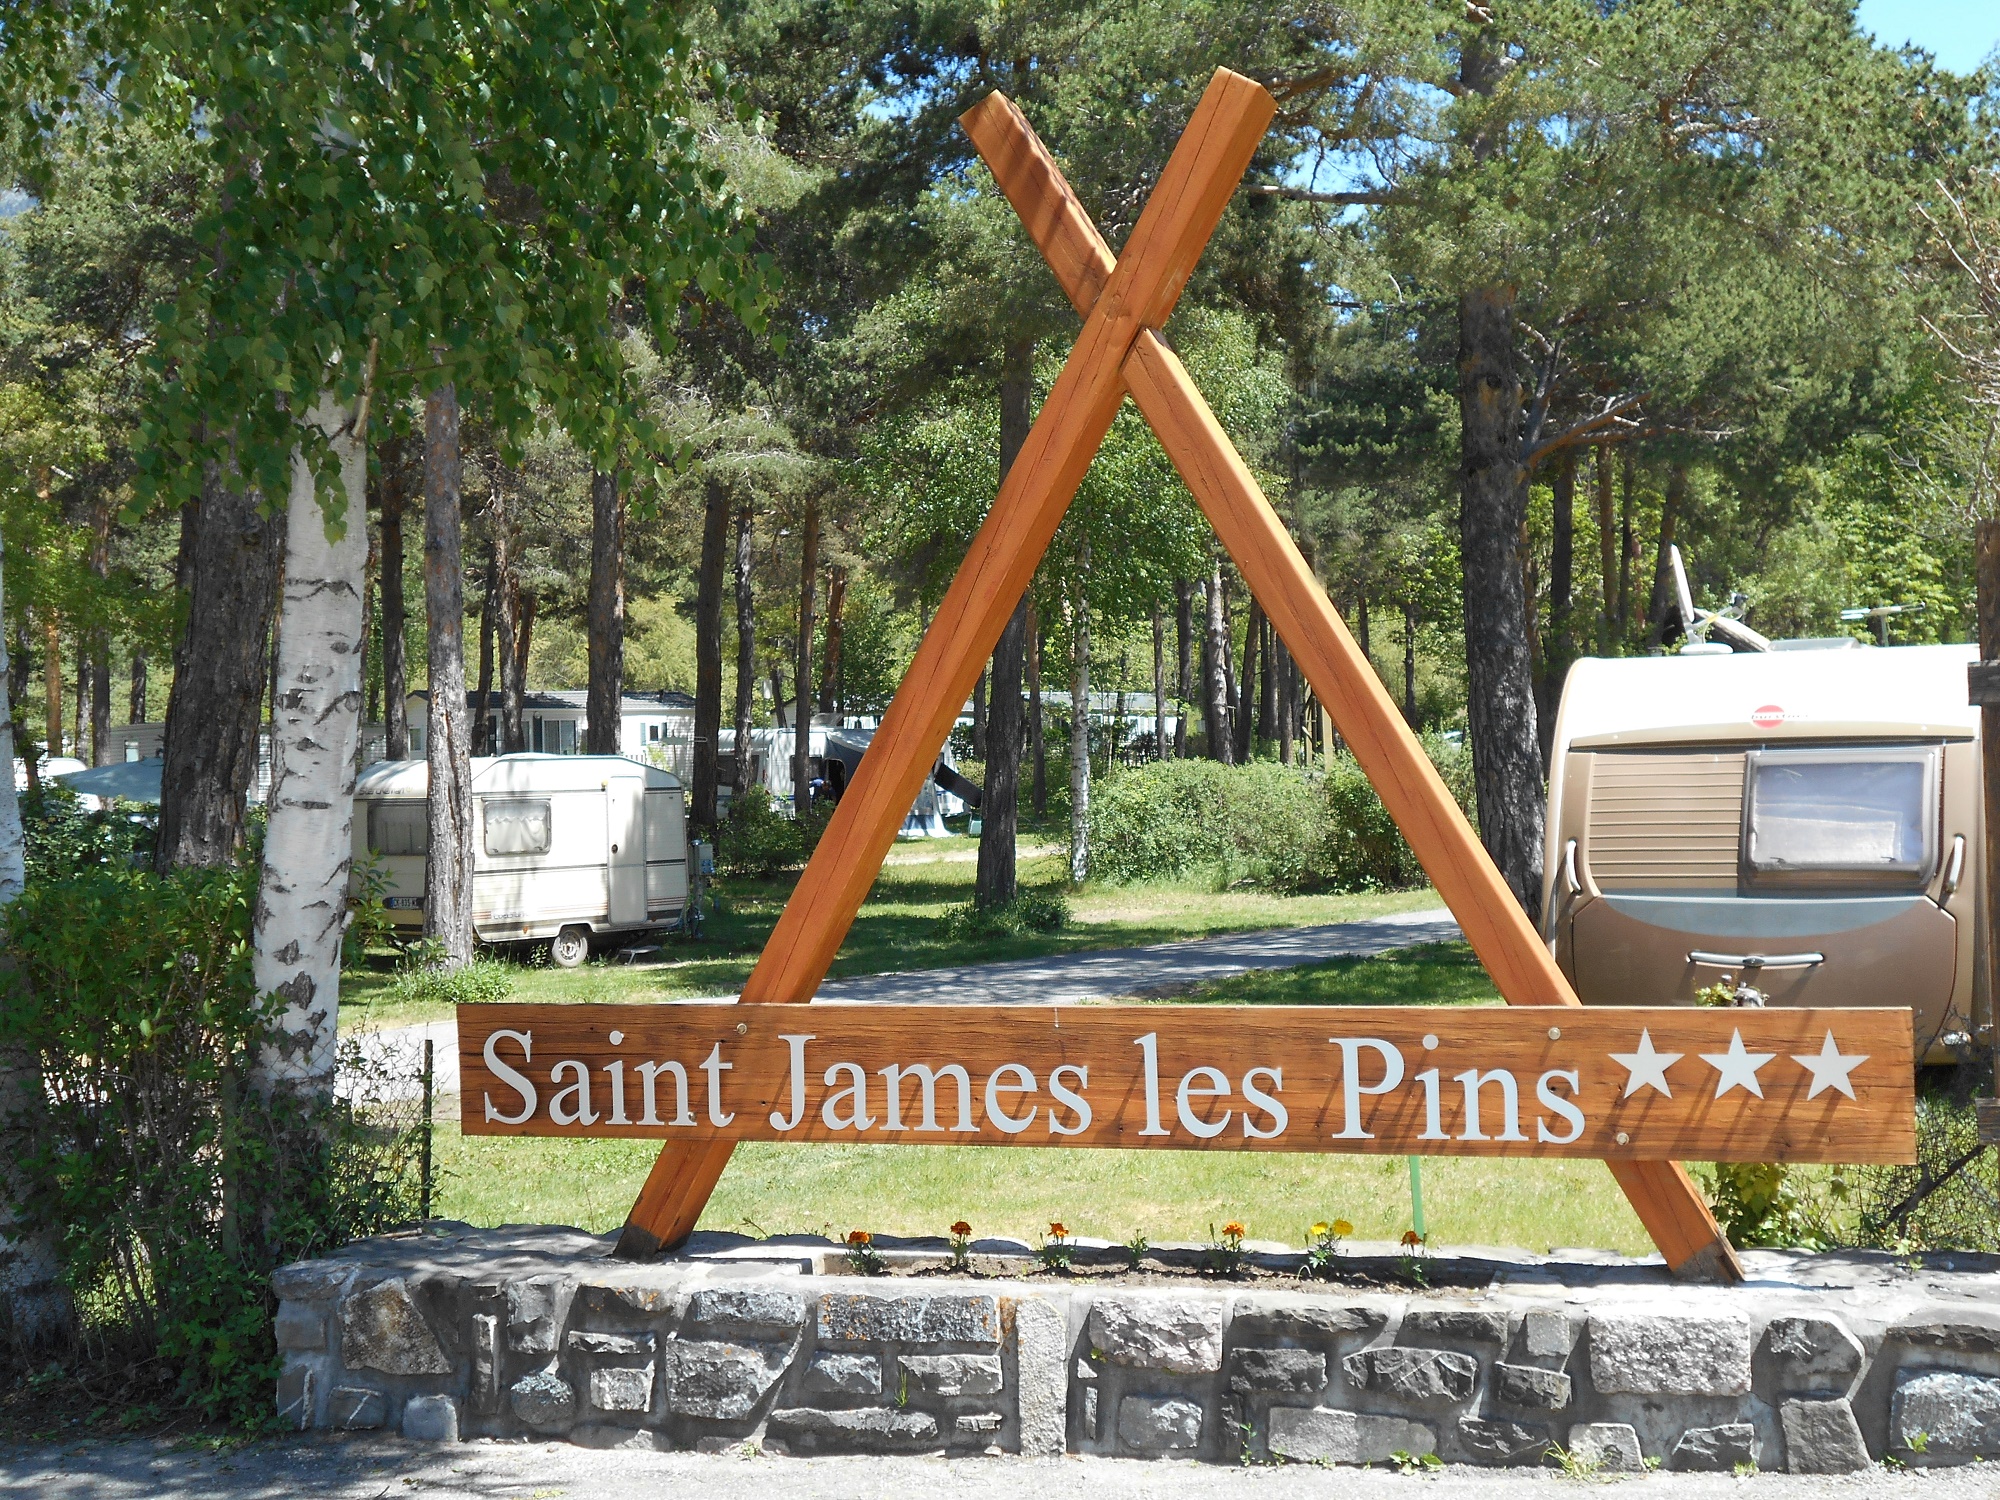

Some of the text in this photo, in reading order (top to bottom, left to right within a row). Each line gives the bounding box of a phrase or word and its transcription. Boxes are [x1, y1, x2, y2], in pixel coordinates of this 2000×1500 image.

[482, 1028, 1586, 1145] Saint James les Pins
